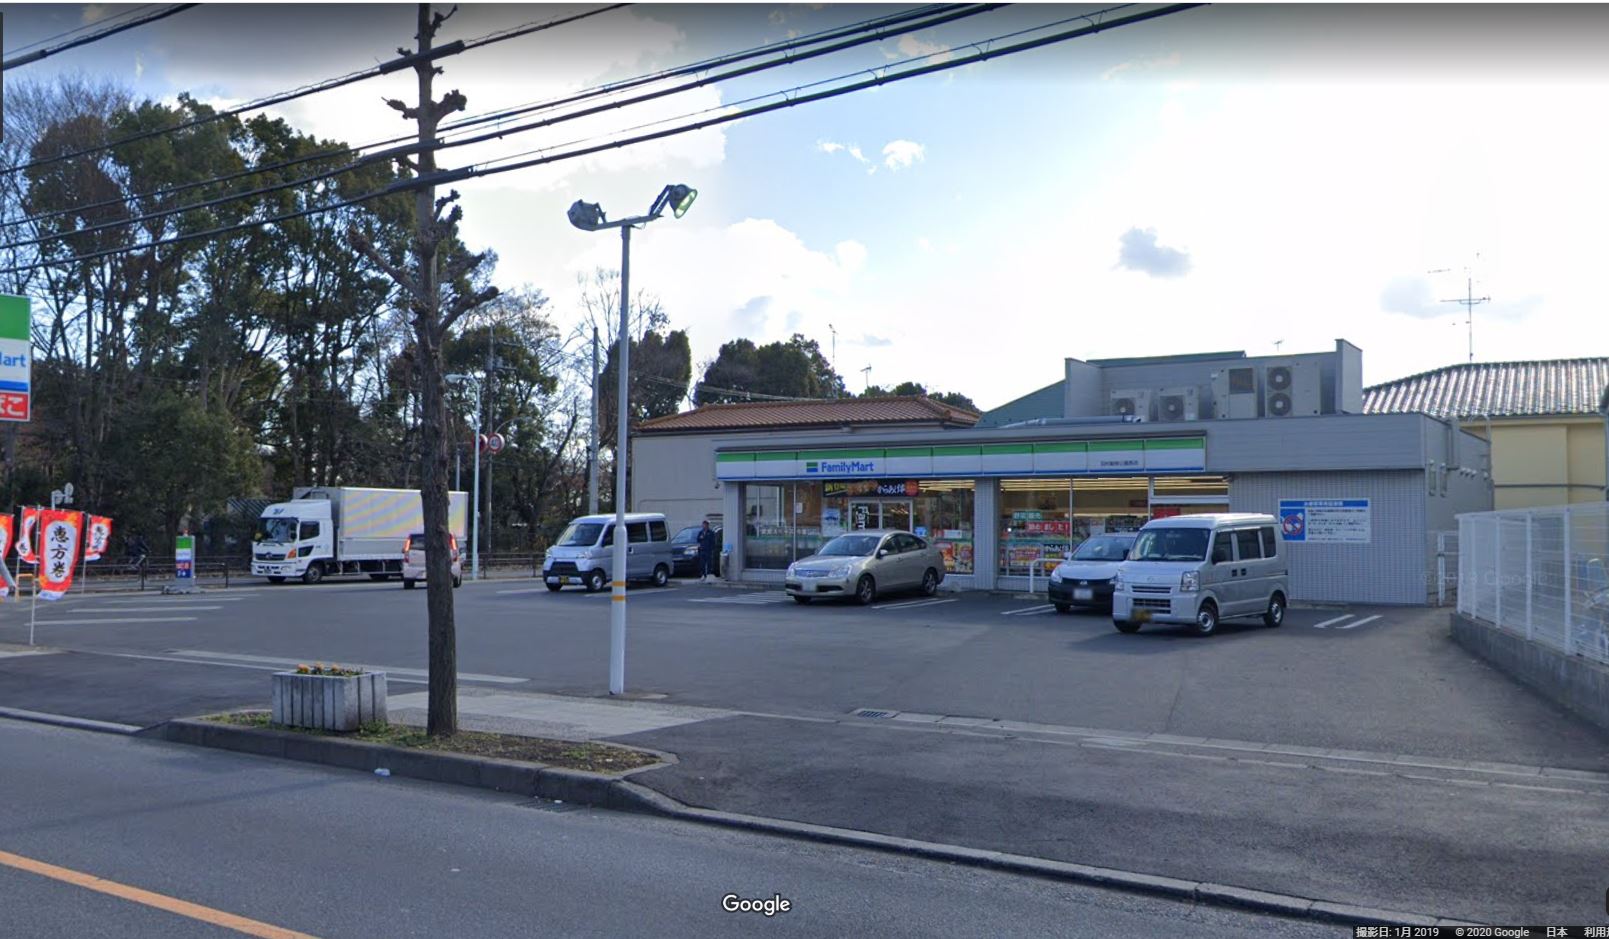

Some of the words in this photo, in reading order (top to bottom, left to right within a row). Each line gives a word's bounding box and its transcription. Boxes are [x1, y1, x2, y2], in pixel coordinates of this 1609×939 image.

[0, 352, 27, 367] art
[821, 461, 874, 473] FamilyMart
[50, 525, 70, 578] 恵方巻
